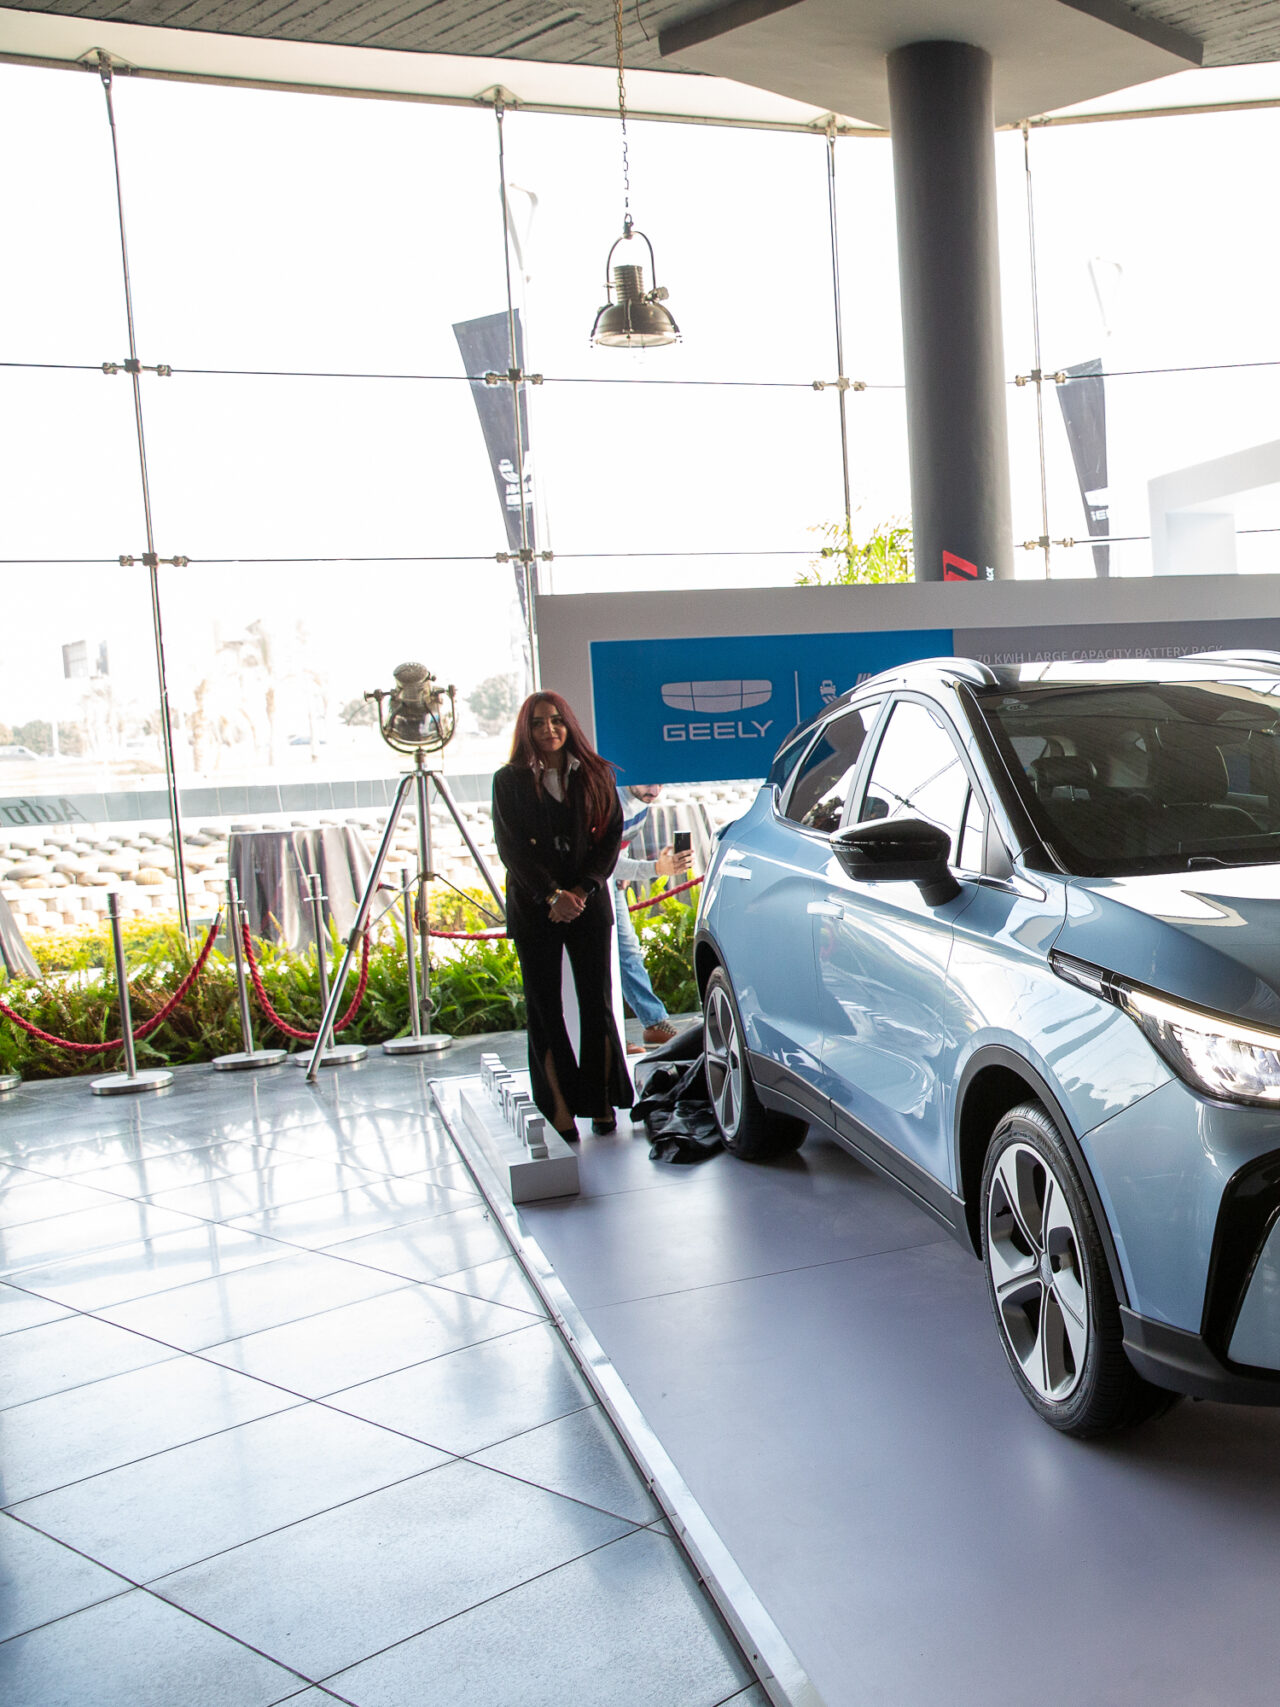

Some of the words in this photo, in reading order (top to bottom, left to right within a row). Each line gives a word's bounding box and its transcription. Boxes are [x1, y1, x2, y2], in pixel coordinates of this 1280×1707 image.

[976, 653, 991, 665] 70
[994, 652, 1025, 665] KWH
[1028, 650, 1068, 662] LARGE
[1071, 648, 1133, 661] CAPACITY
[1135, 646, 1189, 659] BATTERY
[663, 720, 774, 741] GEELY
